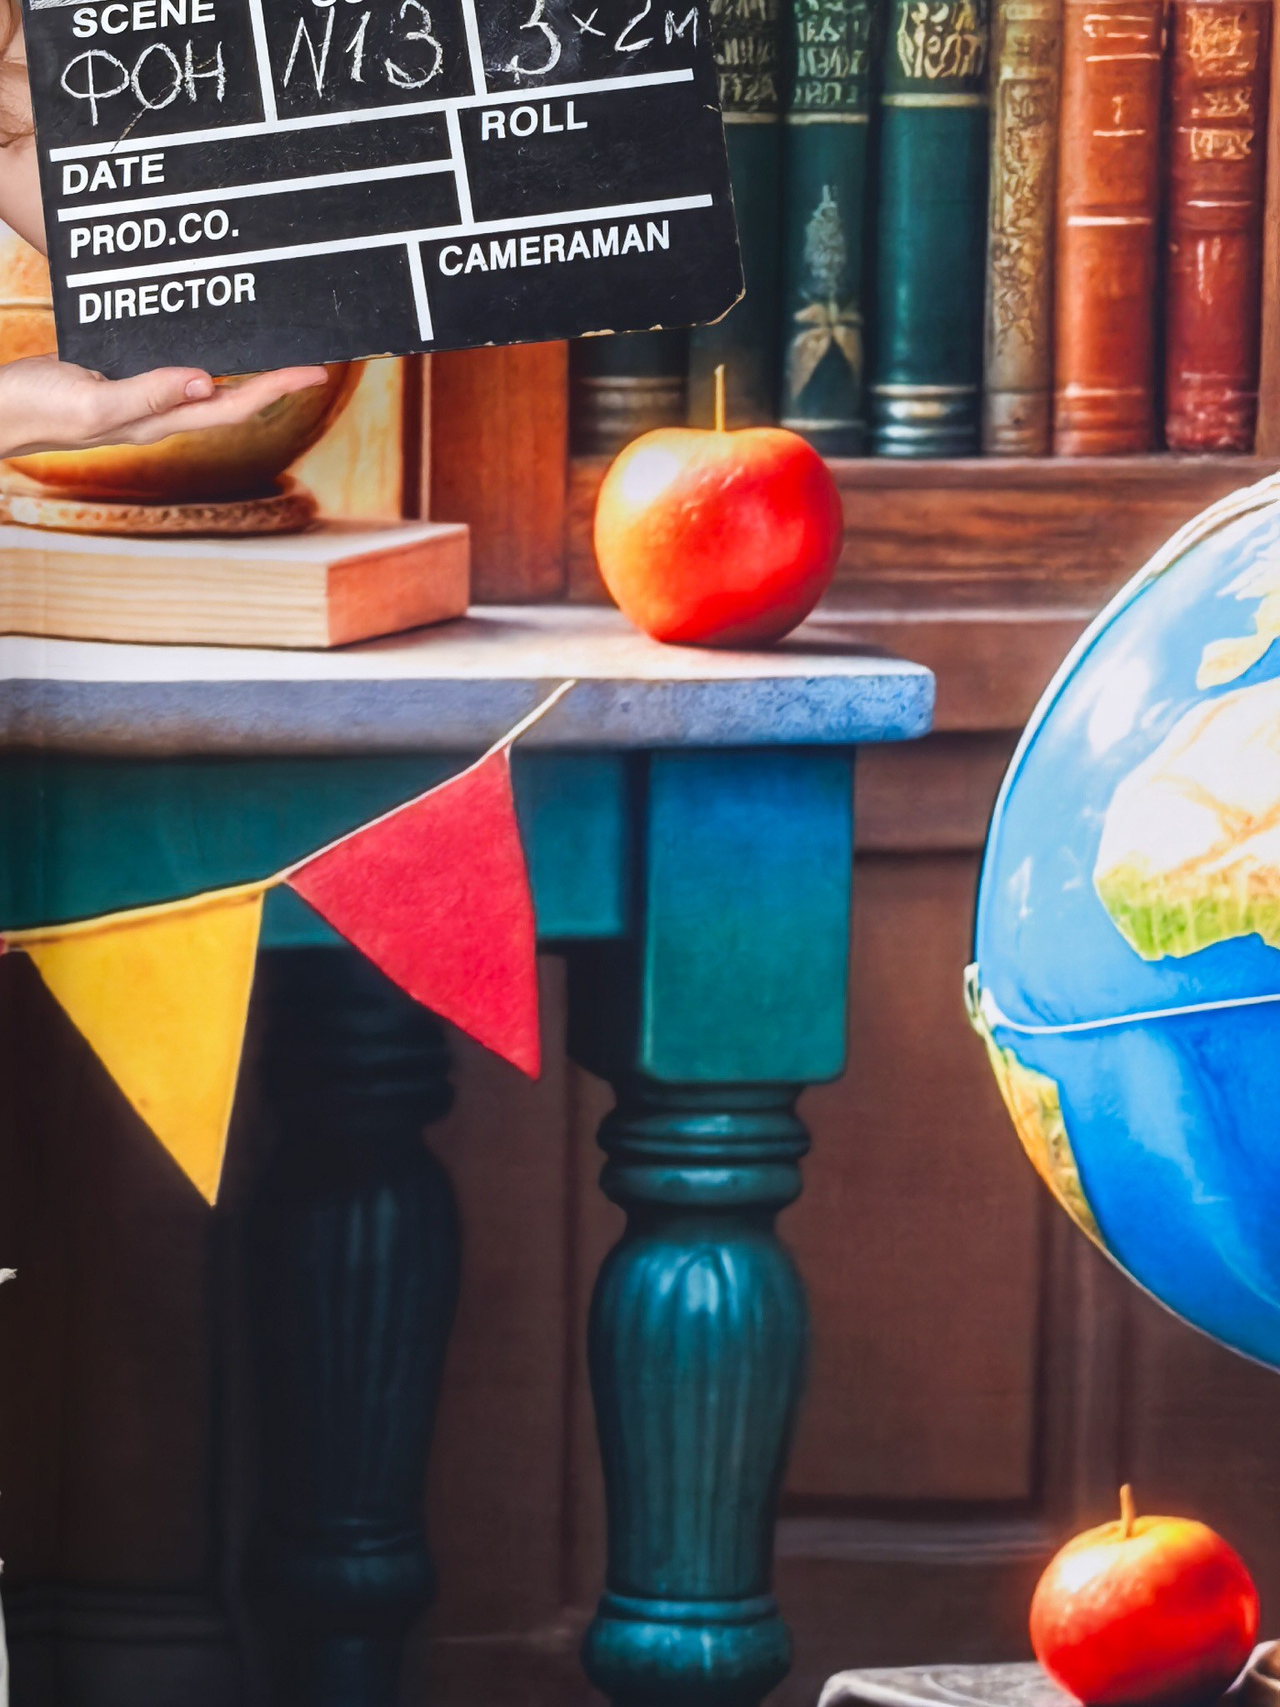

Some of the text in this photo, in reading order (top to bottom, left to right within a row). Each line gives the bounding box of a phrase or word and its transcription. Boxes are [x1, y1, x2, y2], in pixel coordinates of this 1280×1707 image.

[480, 100, 588, 143] ROLL
[61, 152, 166, 196] DATE
[69, 208, 241, 259] PROD.CO.
[438, 219, 671, 277] CAMERAMAN
[77, 272, 257, 324] DIRECTOR
